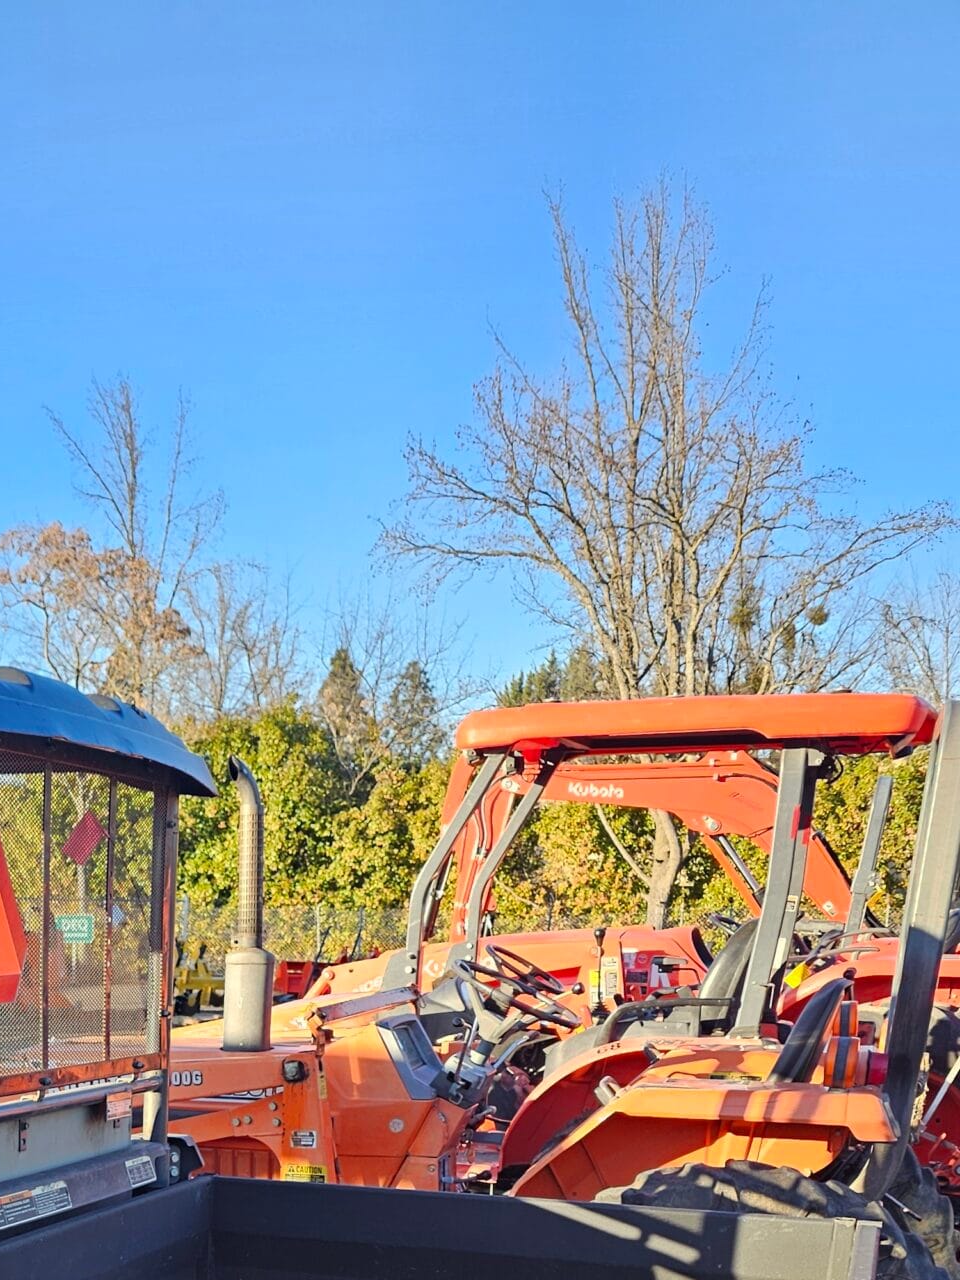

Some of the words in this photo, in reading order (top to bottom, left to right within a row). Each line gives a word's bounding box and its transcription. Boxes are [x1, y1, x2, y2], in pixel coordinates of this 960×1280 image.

[568, 782, 624, 798] Kubota
[169, 1070, 203, 1087] 00G
[296, 1165, 322, 1174] CAUTION
